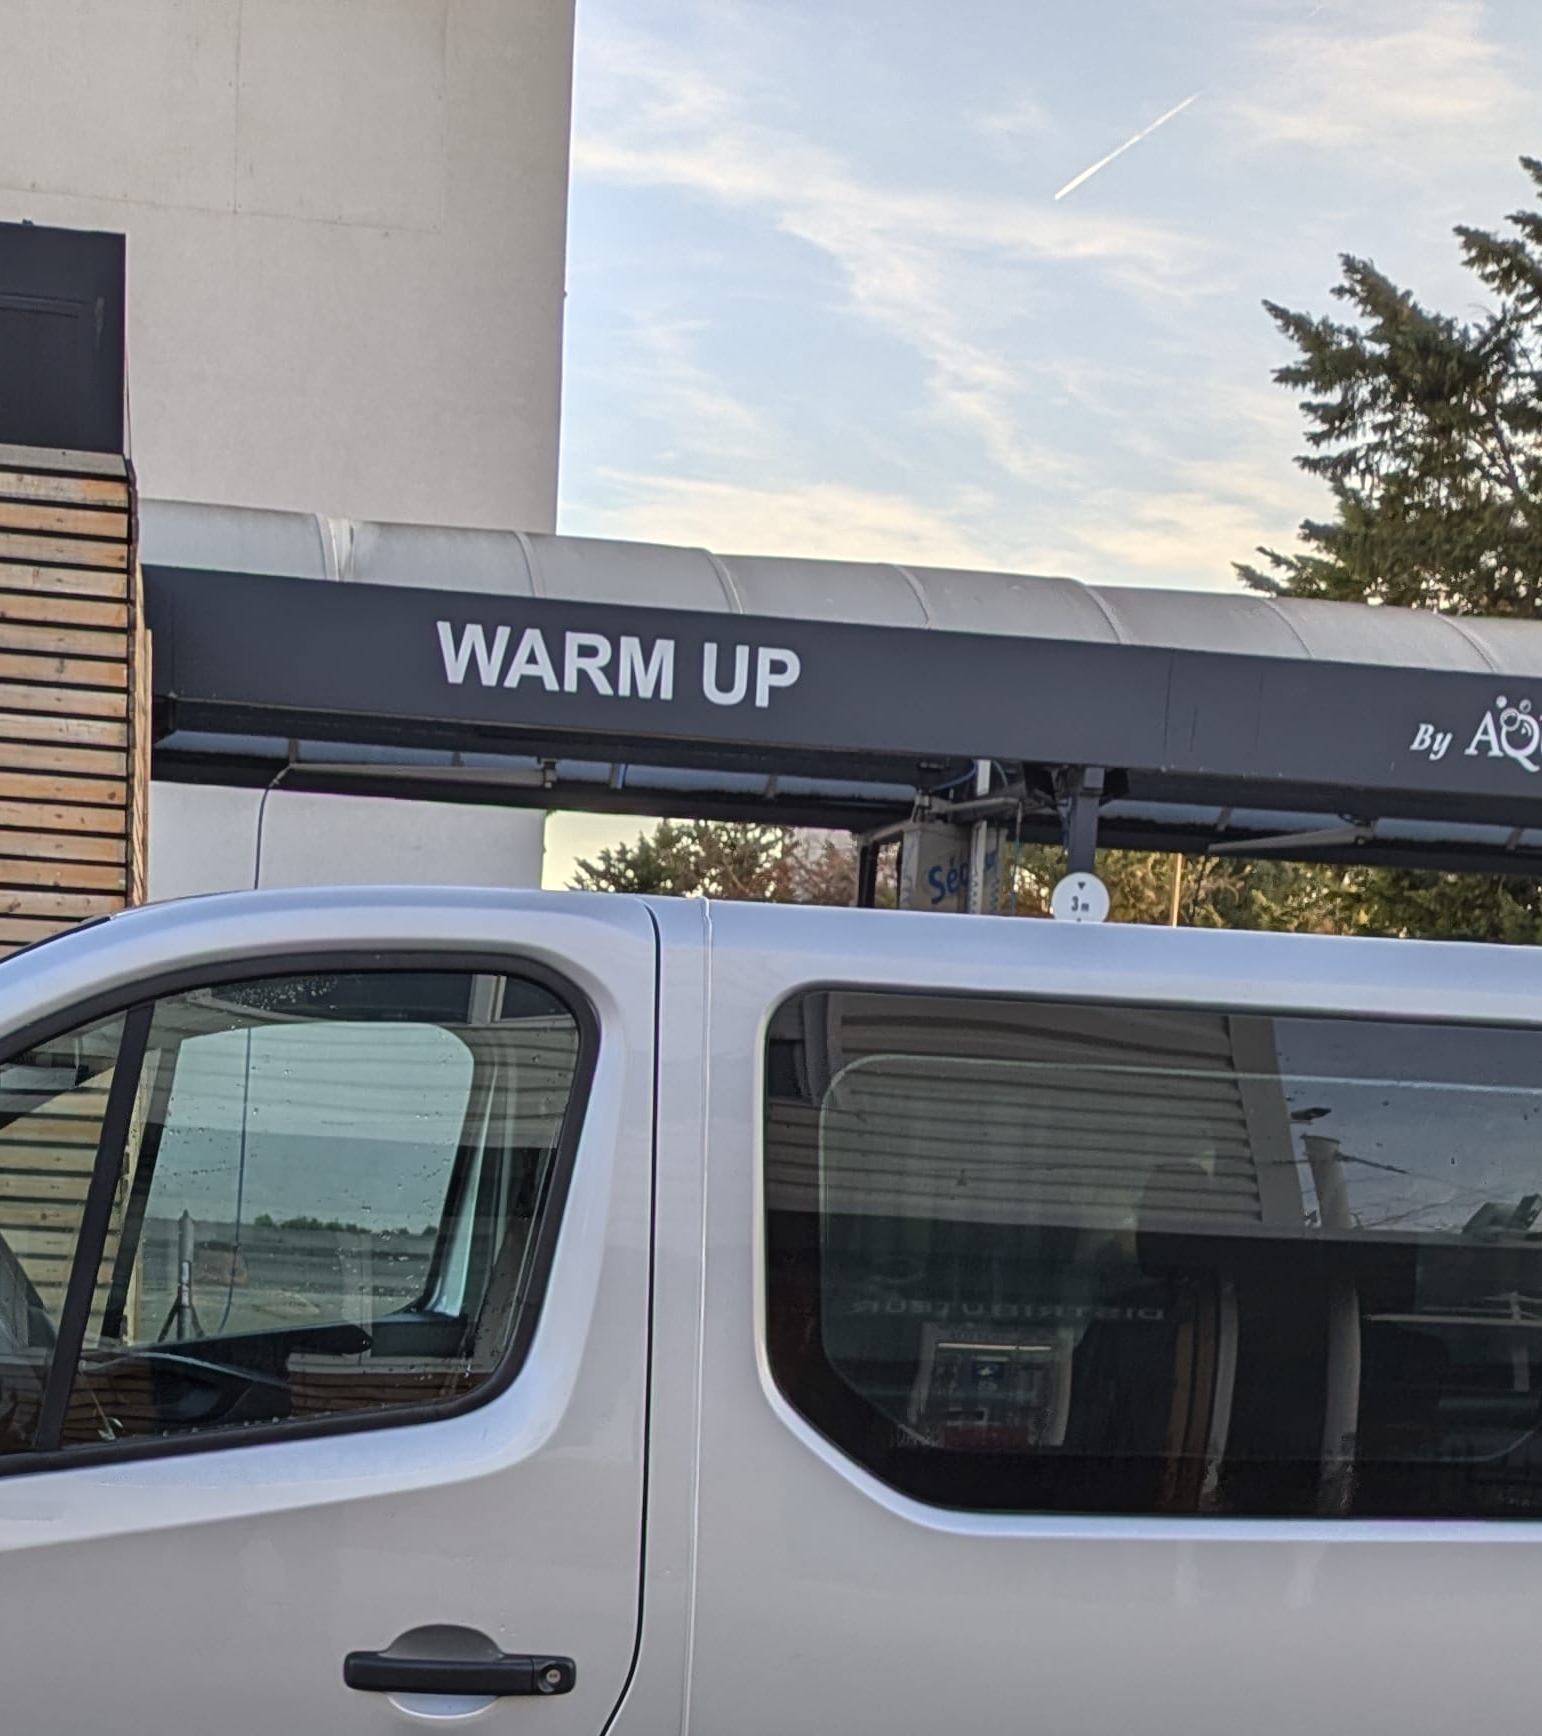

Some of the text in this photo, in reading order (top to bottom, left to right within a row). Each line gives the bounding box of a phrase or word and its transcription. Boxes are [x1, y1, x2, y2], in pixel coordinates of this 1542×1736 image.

[436, 620, 801, 707] WARM UP
[1410, 723, 1453, 761] By
